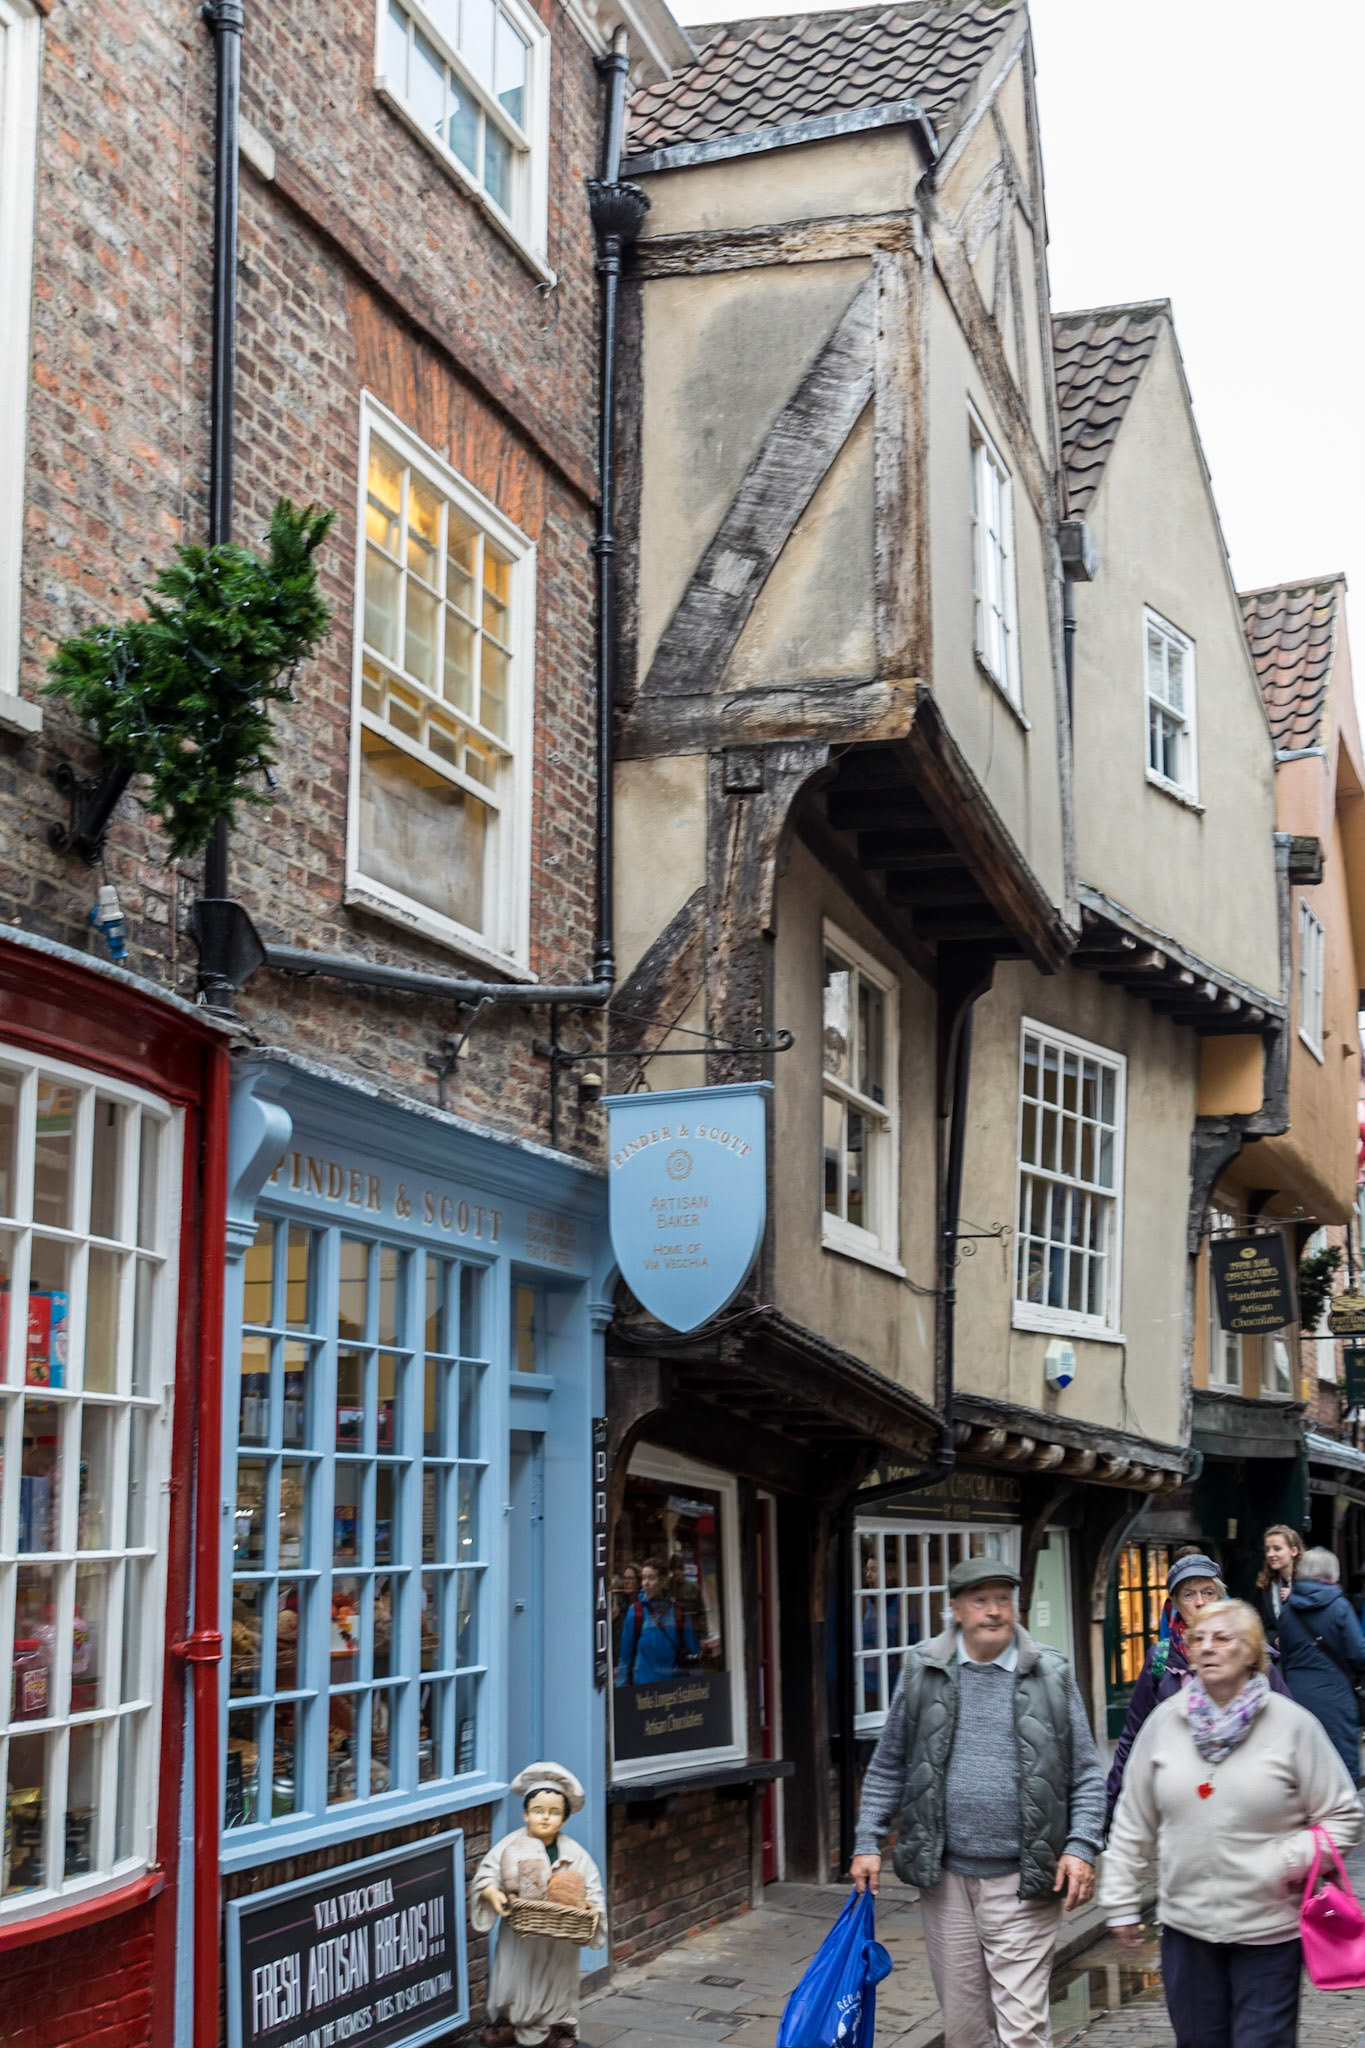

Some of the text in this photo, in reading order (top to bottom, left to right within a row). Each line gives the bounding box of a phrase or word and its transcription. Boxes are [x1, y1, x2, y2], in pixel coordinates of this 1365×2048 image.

[611, 1123, 752, 1169] PINDER & SCOTT
[649, 1195, 709, 1212] ARTISAN
[395, 1183, 412, 1221] &
[422, 1189, 503, 1244] SCOTT
[657, 1213, 701, 1230] BAKER
[652, 1242, 702, 1256] HOME OF
[643, 1258, 660, 1271] VIA
[1227, 1288, 1282, 1302] Handmade
[1240, 1303, 1274, 1314] Artisan
[1230, 1314, 1286, 1329] Chocolates
[594, 1450, 608, 1653] BREAD
[313, 1878, 394, 1931] VIA VECCHIA
[251, 1895, 446, 2034] FRESH ARTISAN BREADS!!!
